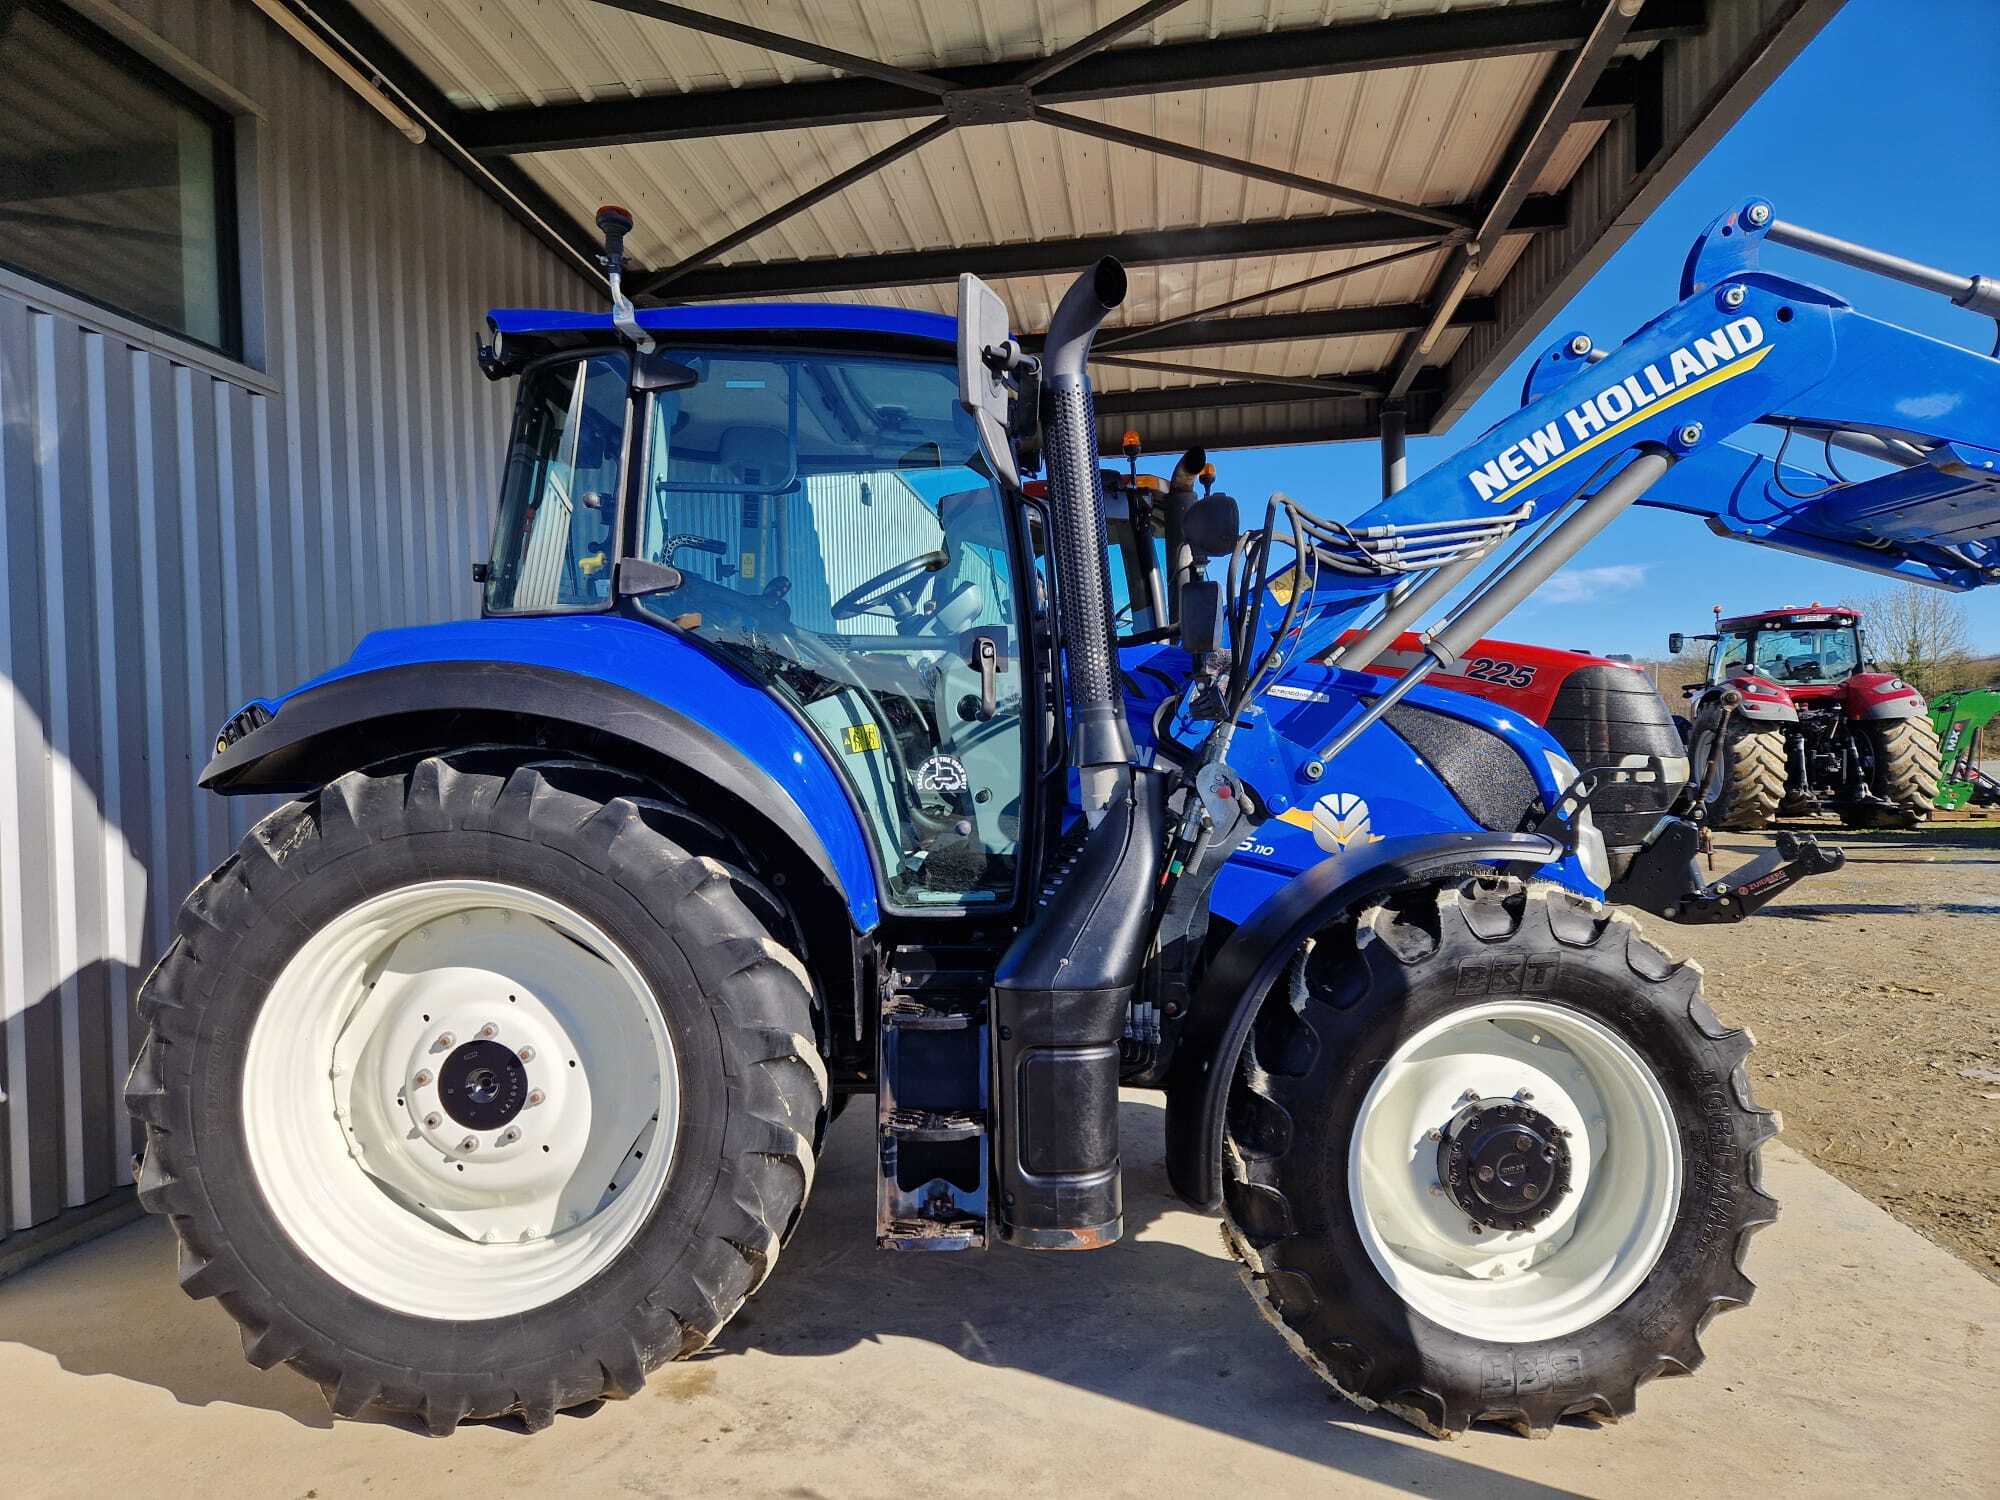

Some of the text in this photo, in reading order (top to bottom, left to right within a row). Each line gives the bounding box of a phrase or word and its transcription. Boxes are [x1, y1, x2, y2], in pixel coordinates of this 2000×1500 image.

[1468, 316, 1765, 501] NEW HOLLAND
[1465, 657, 1537, 689] 225
[1947, 730, 1960, 751] MX
[1459, 960, 1558, 990] BKT
